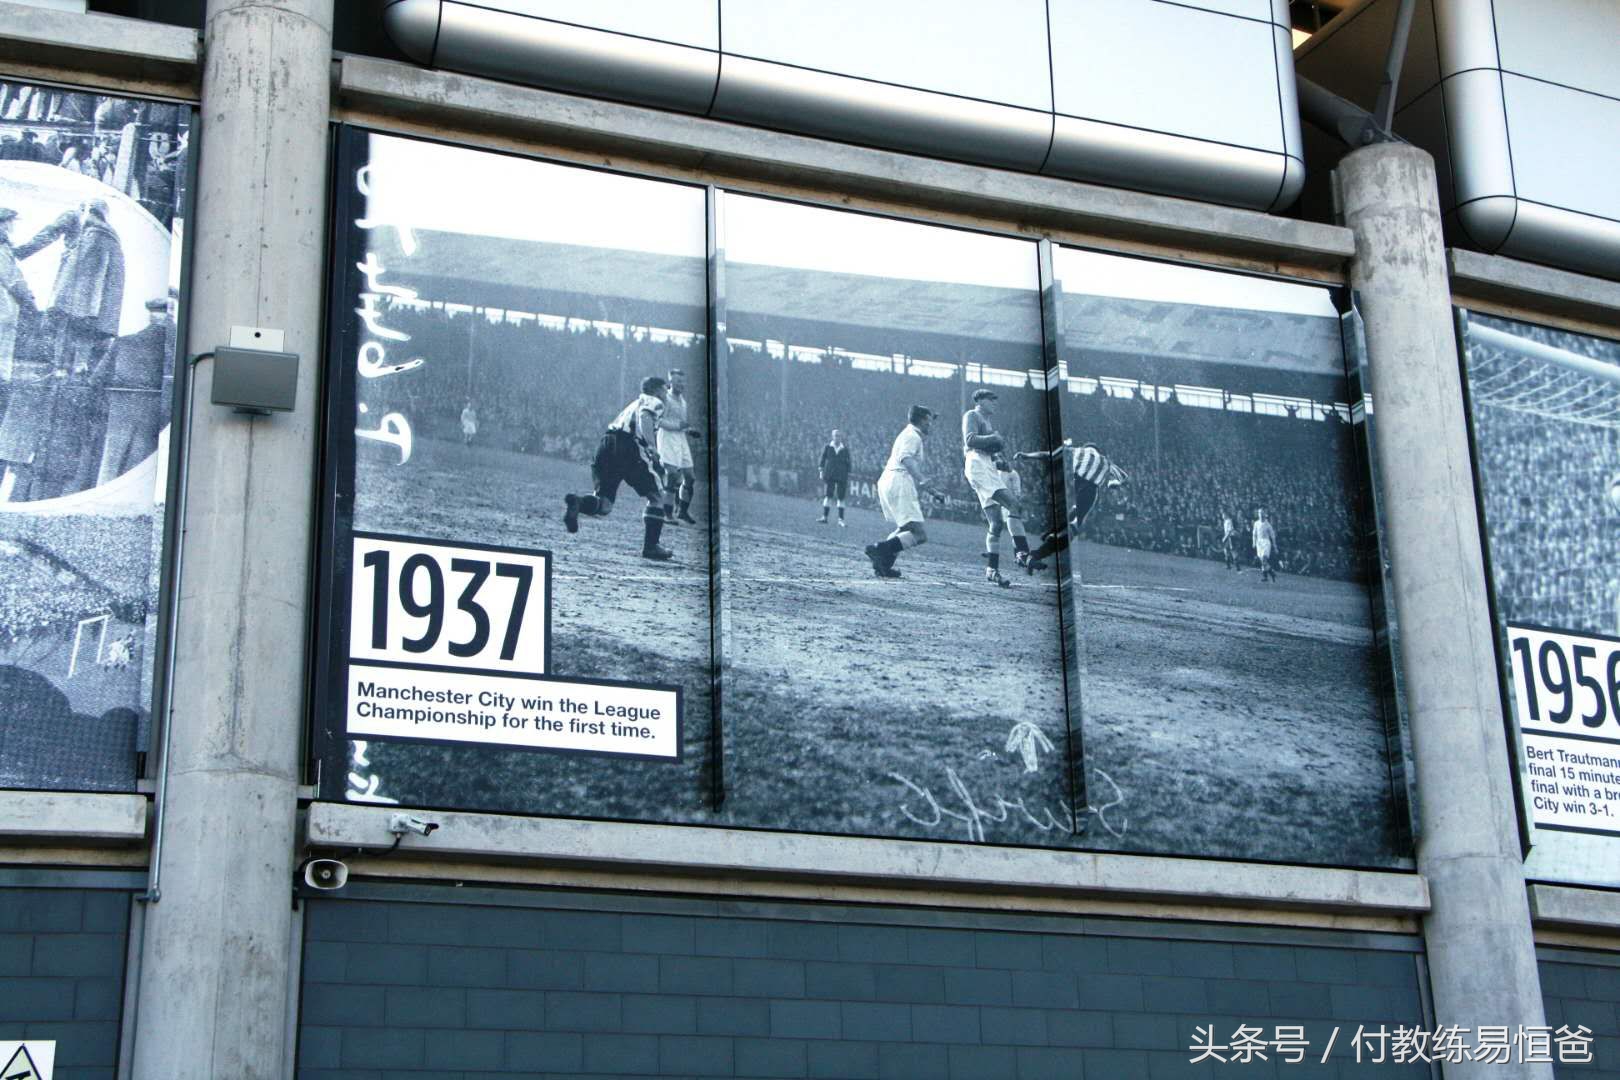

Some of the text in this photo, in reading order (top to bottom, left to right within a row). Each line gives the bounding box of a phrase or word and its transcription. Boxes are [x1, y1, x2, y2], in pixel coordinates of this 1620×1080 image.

[364, 549, 533, 661] 1937
[357, 681, 661, 722] Manchester City win the League
[356, 702, 656, 739] Championship for the first time.
[1526, 745, 1554, 761] Bert
[1528, 762, 1556, 778] final
[1560, 766, 1575, 780] 15
[1531, 779, 1620, 801] final with a br
[1534, 796, 1615, 817] City win 3-1.
